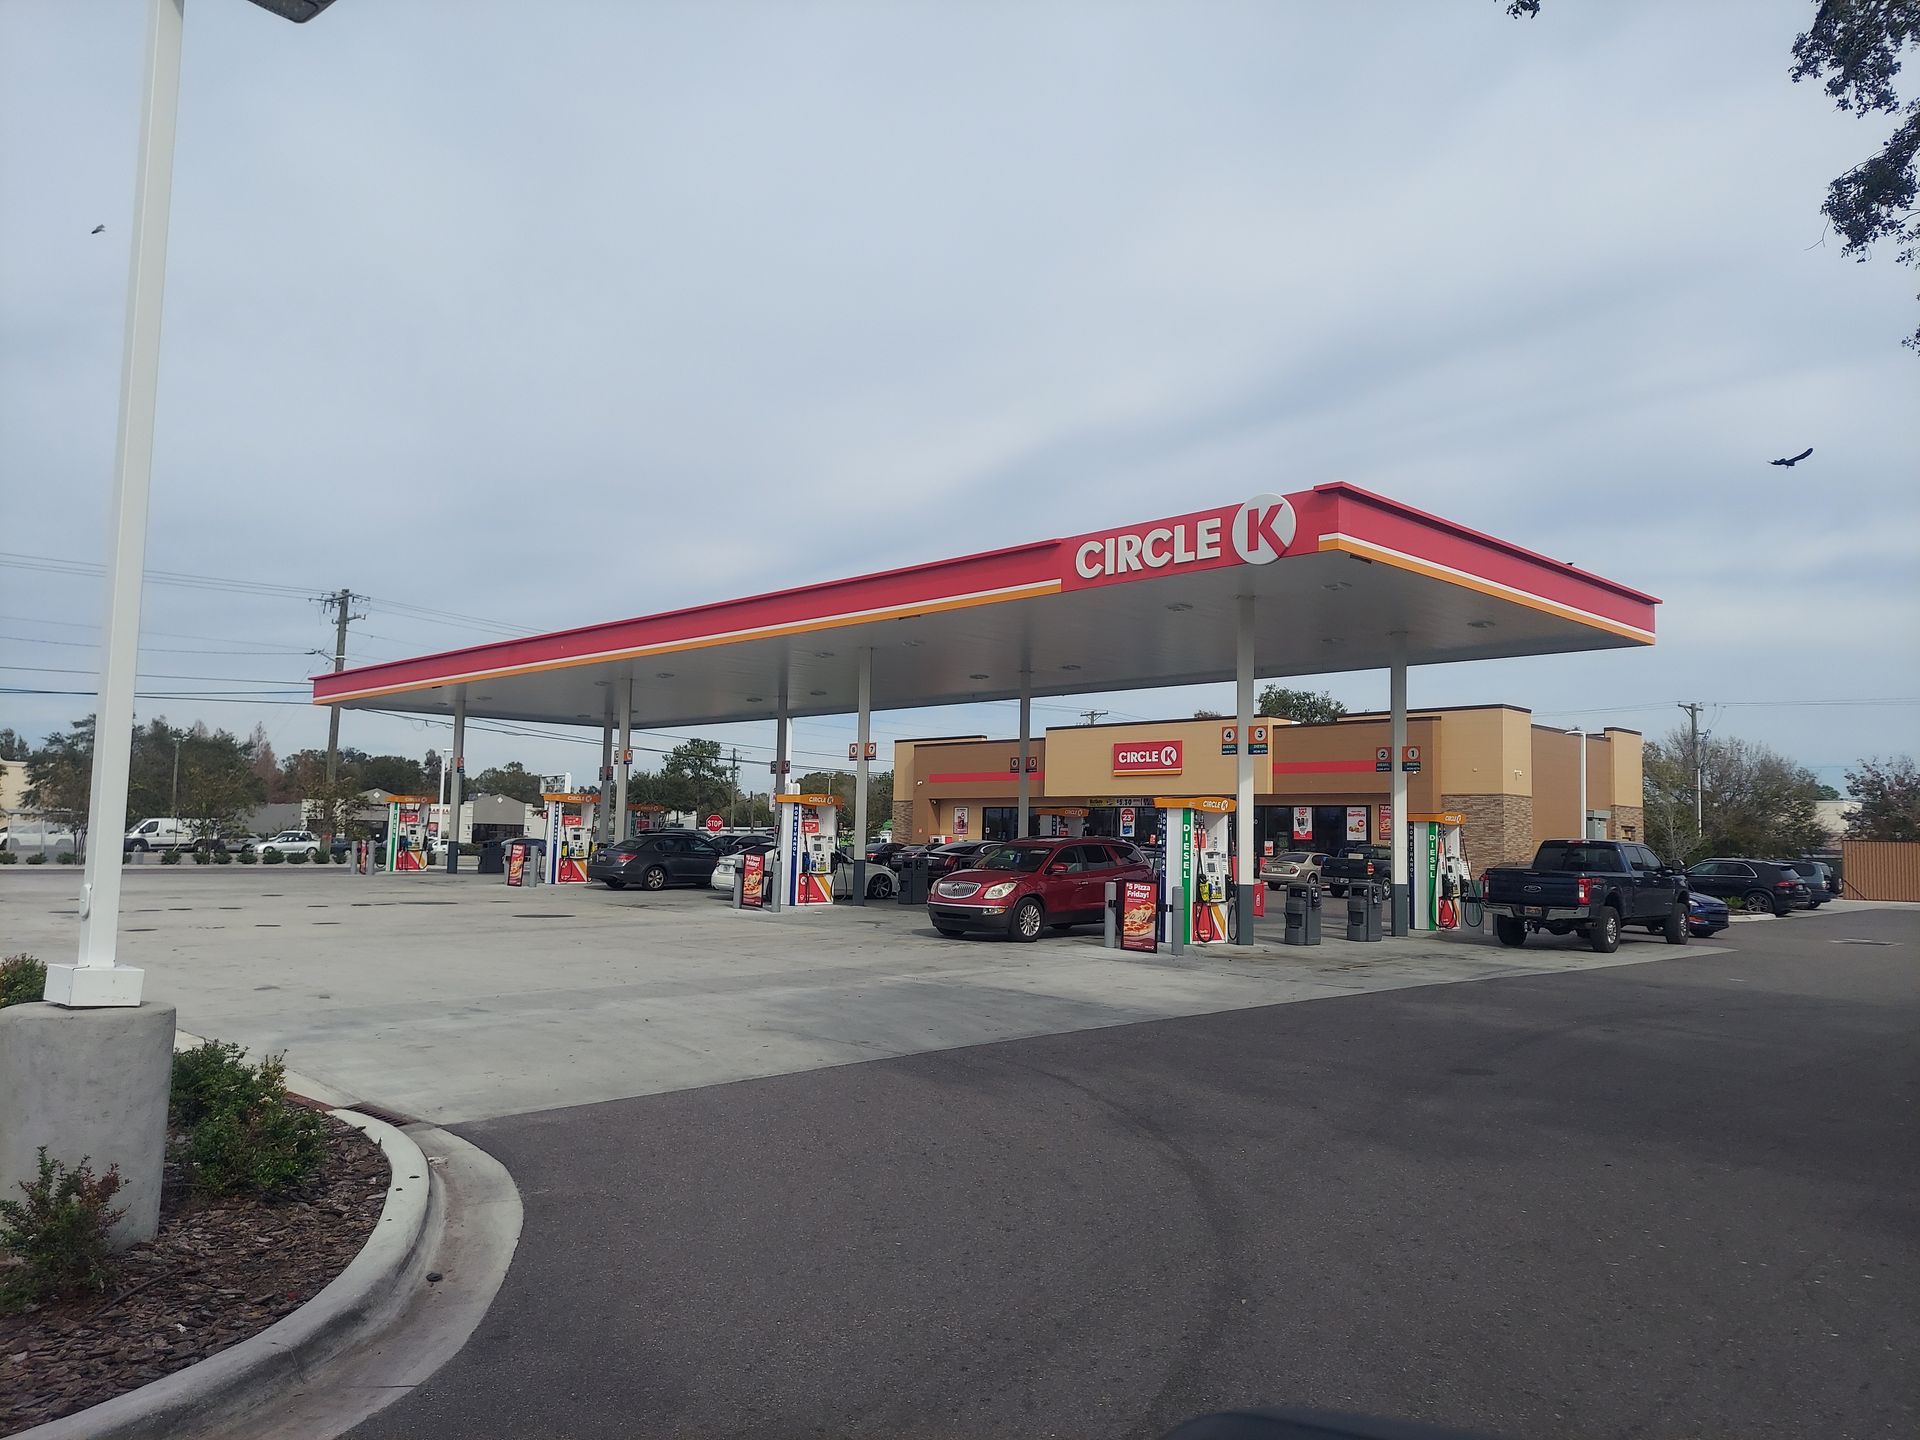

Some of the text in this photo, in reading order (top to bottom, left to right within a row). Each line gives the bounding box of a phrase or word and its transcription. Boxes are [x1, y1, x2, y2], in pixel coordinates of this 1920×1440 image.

[1075, 500, 1291, 579] CIRCLE K
[1225, 731, 1232, 739] 4
[1257, 730, 1263, 738] 3
[1118, 750, 1159, 763] CIRCLE
[1203, 799, 1221, 809] CIRCLE
[707, 819, 722, 827] STOP
[1183, 824, 1191, 879] DIESEL
[1133, 883, 1151, 891] Pizza
[1127, 890, 1150, 899] Friday!
